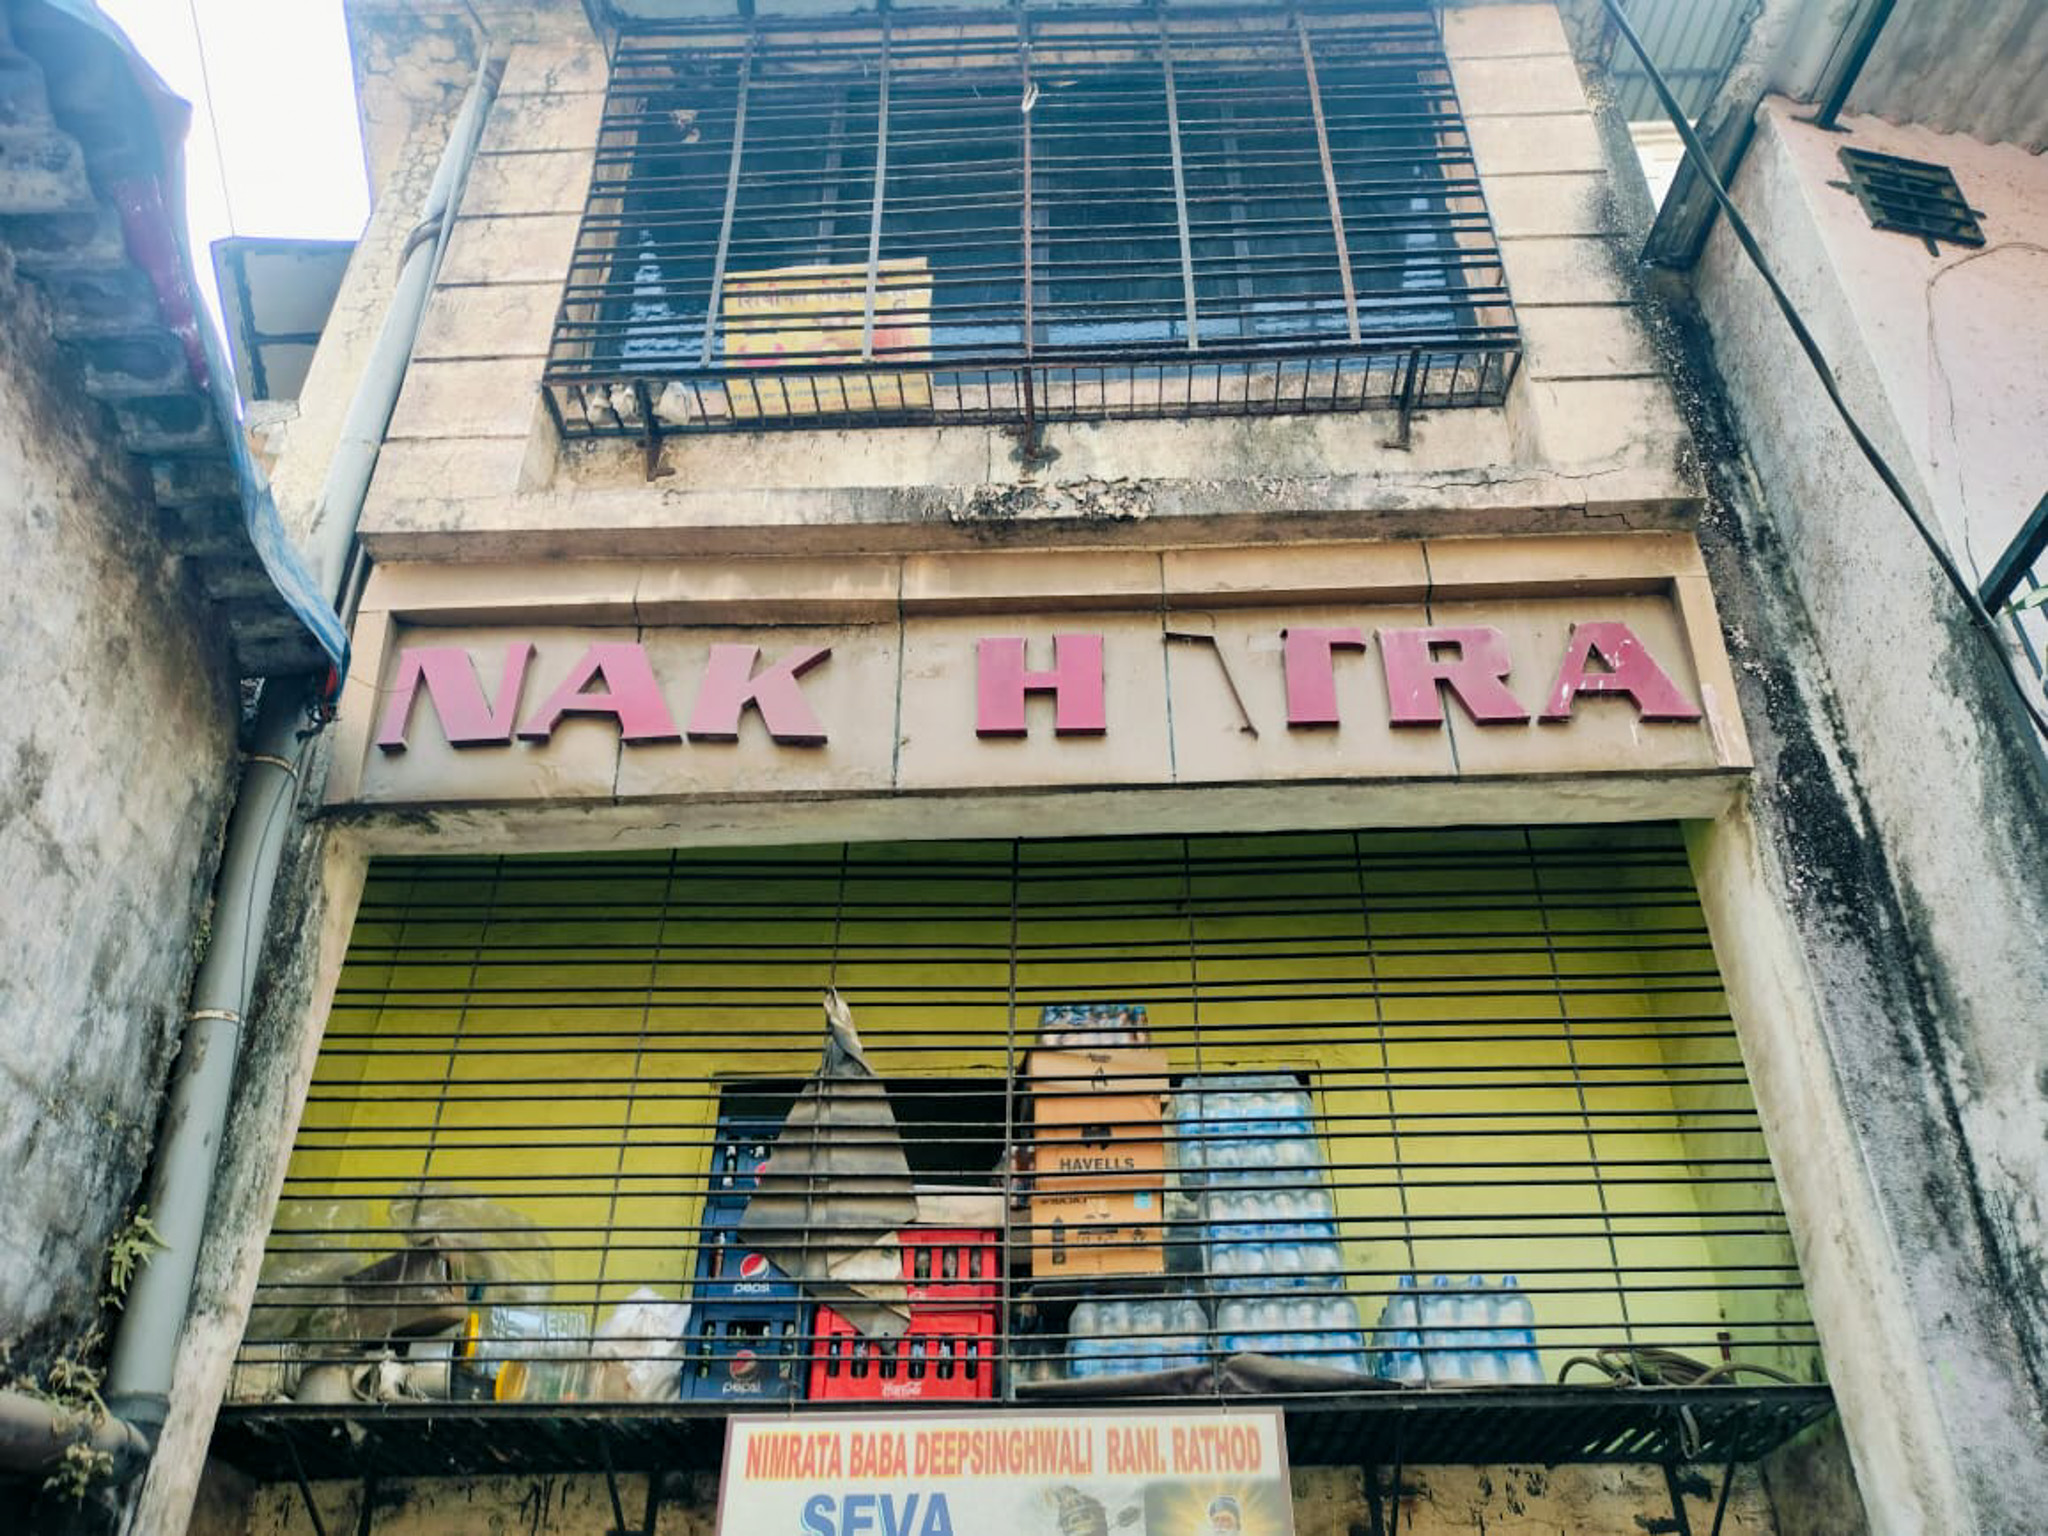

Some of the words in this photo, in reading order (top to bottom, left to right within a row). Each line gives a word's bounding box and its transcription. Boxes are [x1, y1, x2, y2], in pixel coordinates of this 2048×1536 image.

[1060, 1158, 1134, 1171] HAVELLS
[732, 1282, 770, 1294] pepsi
[745, 1432, 842, 1481] NIMRATA
[849, 1431, 908, 1479] BABA
[914, 1427, 1093, 1478] DEEPSINGHWALI
[1172, 1425, 1262, 1474] RATHOD
[801, 1492, 955, 1536] SEVA
